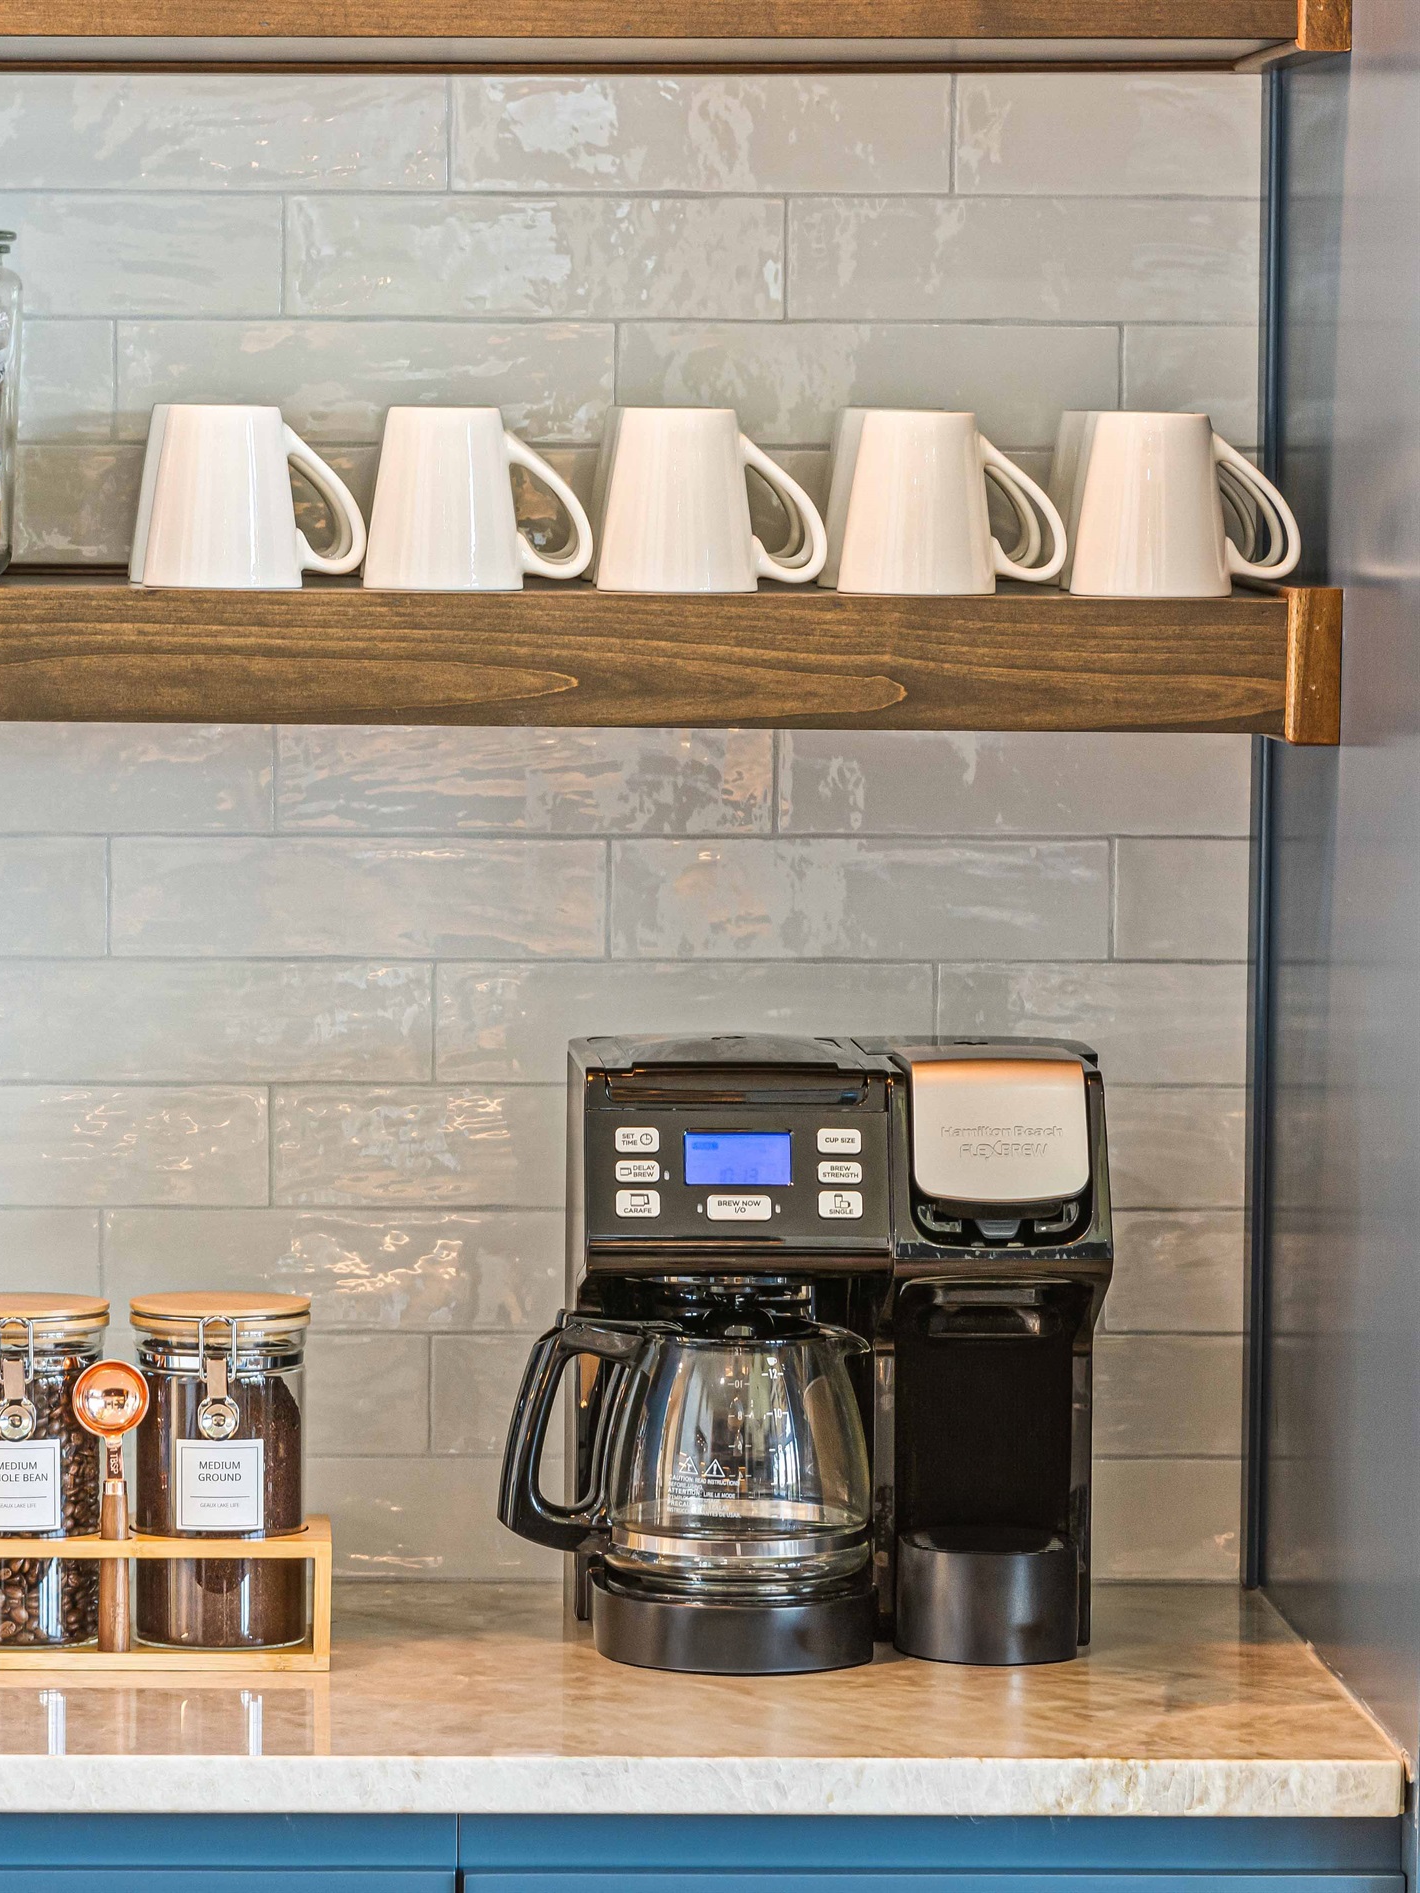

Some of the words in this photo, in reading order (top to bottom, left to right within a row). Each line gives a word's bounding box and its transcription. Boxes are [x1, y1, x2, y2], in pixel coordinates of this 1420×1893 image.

[940, 1125, 1011, 1137] Hamilton
[1013, 1125, 1063, 1137] Beach
[960, 1140, 1048, 1160] FLEXBREW
[768, 1368, 778, 1379] 12
[773, 1408, 783, 1419] 10
[109, 1453, 119, 1475] TBSP
[199, 1461, 241, 1470] MEDIUM
[22, 1473, 48, 1482] BEAN
[198, 1473, 242, 1482] GROUND
